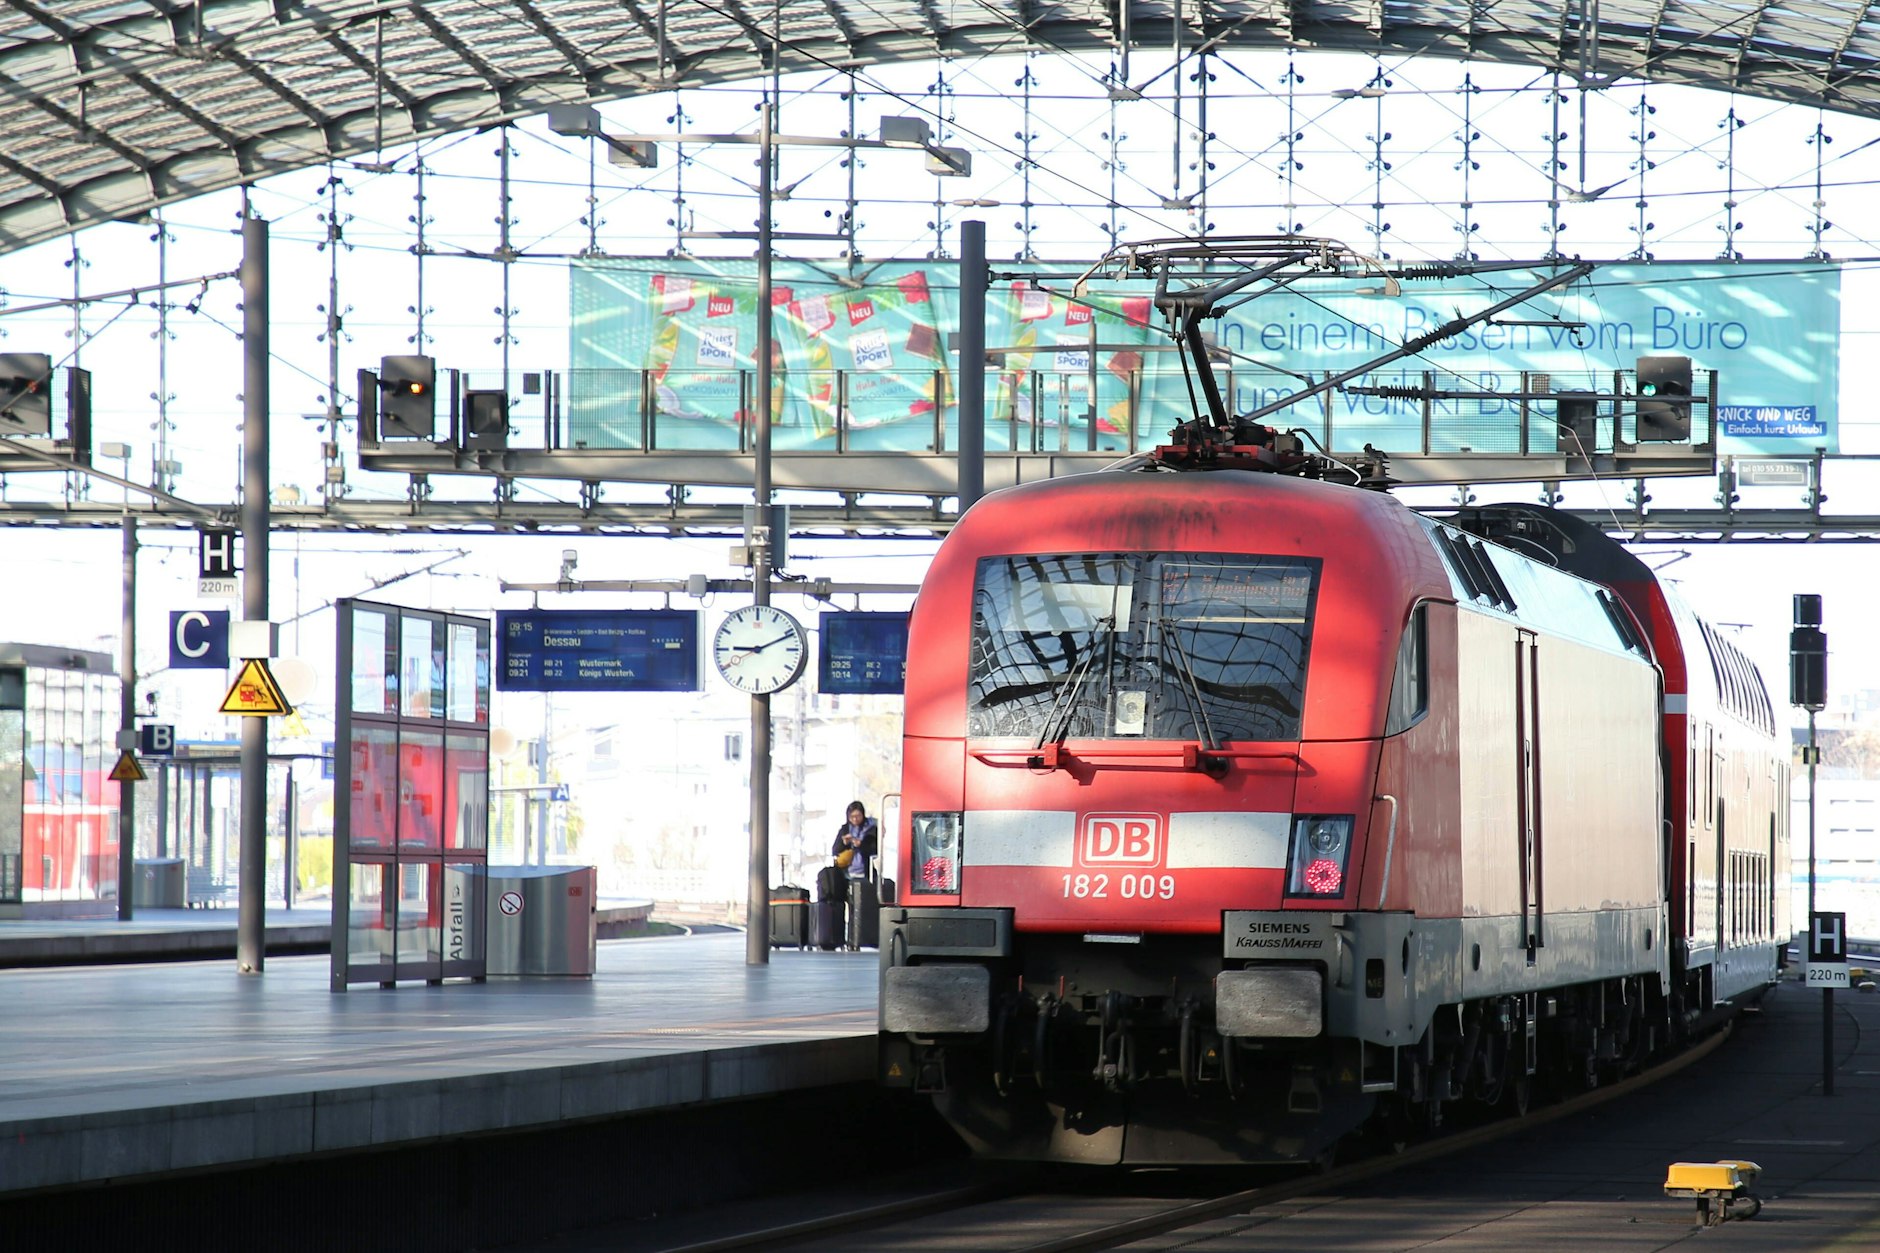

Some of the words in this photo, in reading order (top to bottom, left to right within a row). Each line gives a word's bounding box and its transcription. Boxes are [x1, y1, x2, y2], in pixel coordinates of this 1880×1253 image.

[710, 302, 731, 313] NEU
[851, 306, 871, 319] NEU
[1068, 311, 1088, 321] NEU
[1261, 312, 1385, 350] einem
[1544, 318, 1634, 350] vom
[1653, 306, 1748, 350] Büro
[856, 350, 888, 365] SPORT
[1057, 355, 1089, 367] SPORT
[1309, 367, 1460, 415] Waikki
[1479, 367, 1614, 415] Bah
[1717, 407, 1752, 421] KNICK
[1756, 407, 1781, 421] UND
[1784, 407, 1811, 421] WEG
[1728, 424, 1762, 434] Einfach
[1764, 424, 1784, 434] kurz
[1787, 424, 1822, 434] Urlaub!
[203, 534, 229, 571] H
[201, 582, 221, 592] 220
[224, 584, 234, 592] m
[509, 622, 533, 631] 09:15
[176, 611, 211, 658] C
[544, 635, 581, 647] Dessau
[554, 659, 563, 667] 21
[579, 659, 622, 667] Wustermark
[831, 661, 851, 669] 09:25
[876, 661, 881, 669] 2
[554, 669, 563, 677] 22
[579, 668, 602, 678] Königs
[604, 669, 635, 677] Wusterh.
[831, 671, 851, 679] 10:14
[876, 671, 881, 679] 7
[153, 725, 171, 750] B
[556, 784, 569, 799] A
[1091, 821, 1151, 857] DB
[1062, 873, 1109, 898] 182
[1120, 874, 1175, 899] 009
[450, 901, 463, 961] Abfall
[1249, 922, 1311, 934] SIEMENS
[1814, 917, 1840, 954] H
[1810, 969, 1832, 981] 220
[1834, 971, 1846, 981] m
